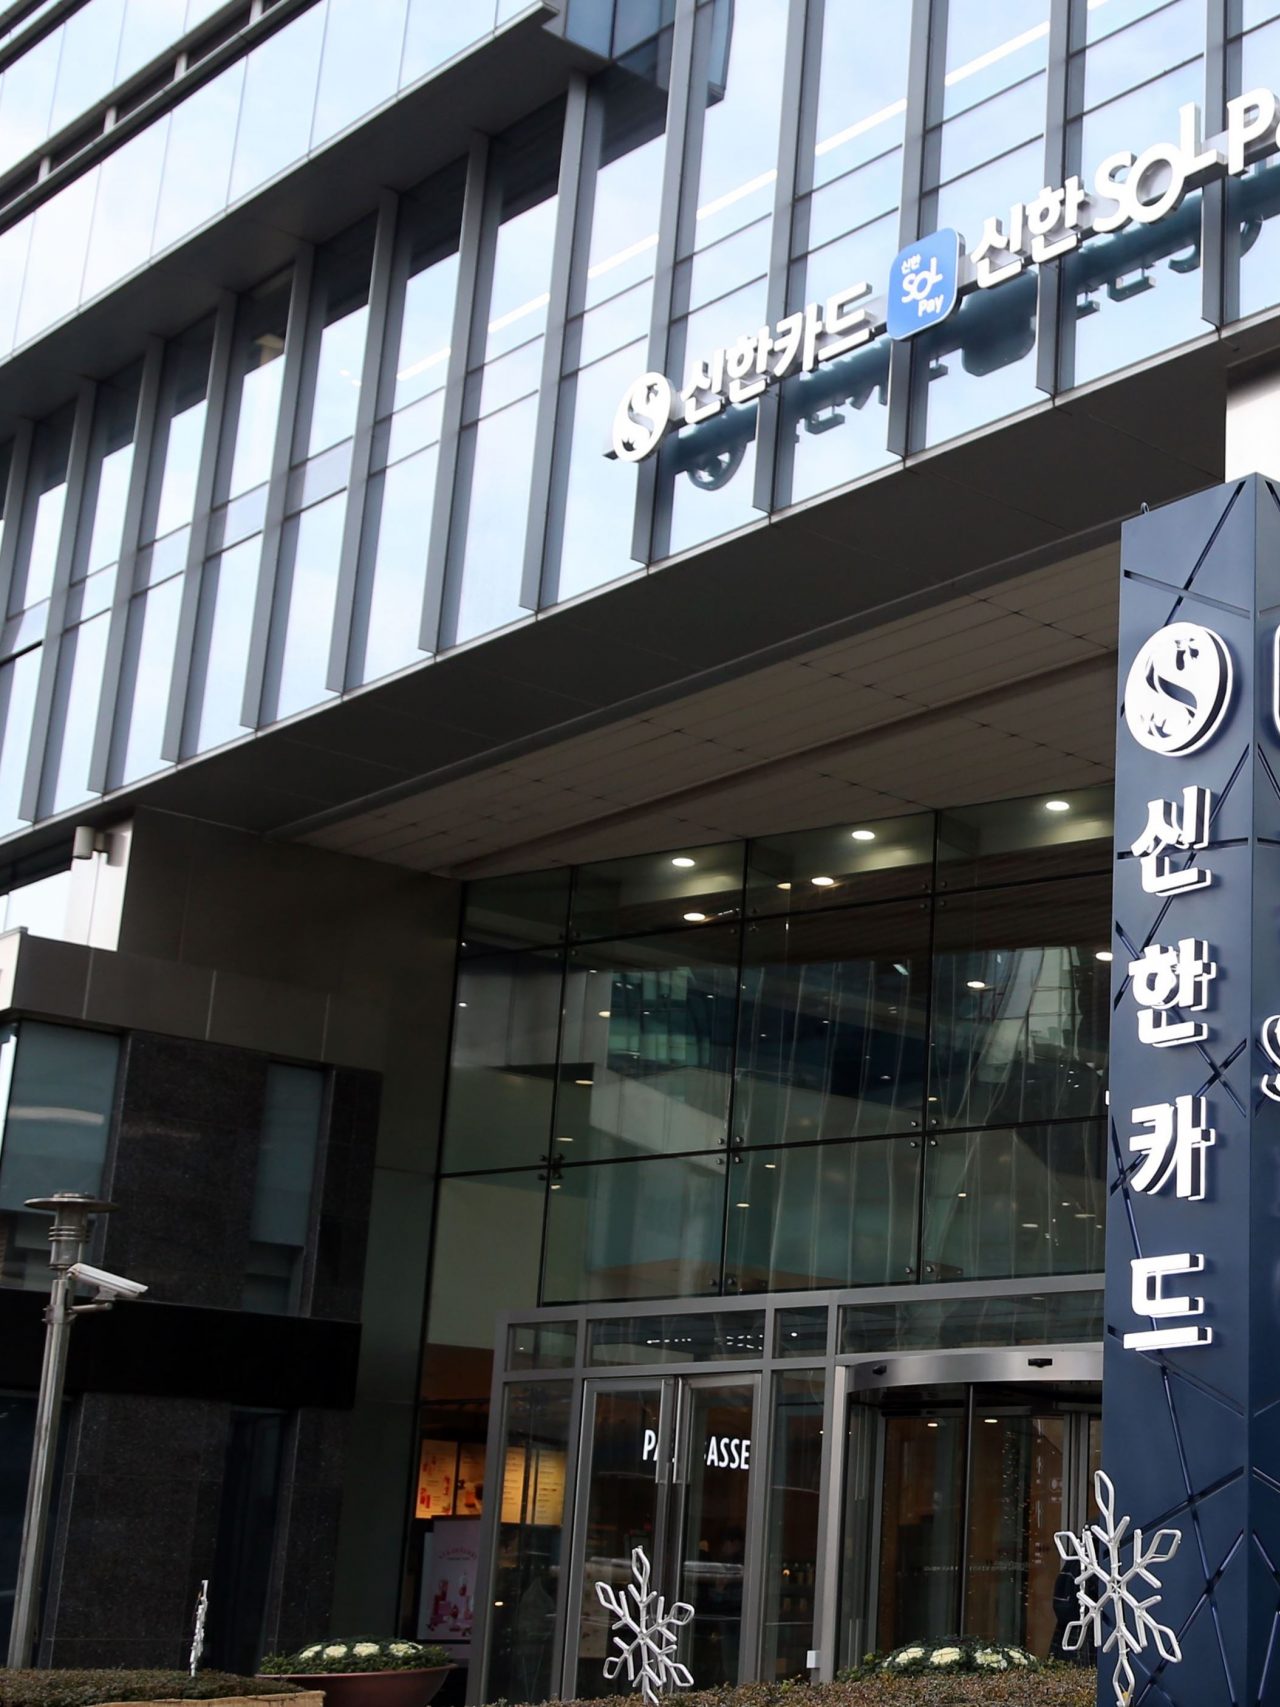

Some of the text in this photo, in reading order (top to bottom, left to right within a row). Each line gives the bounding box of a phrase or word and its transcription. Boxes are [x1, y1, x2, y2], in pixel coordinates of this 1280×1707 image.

[970, 175, 1084, 289] 신한
[1092, 102, 1218, 233] SOL
[901, 254, 921, 275] 신한
[902, 256, 943, 303] SOL
[918, 294, 944, 317] Pay
[680, 281, 872, 424] 신한카드
[1123, 785, 1211, 1350] 신한카드
[704, 1436, 751, 1470] ASSE
